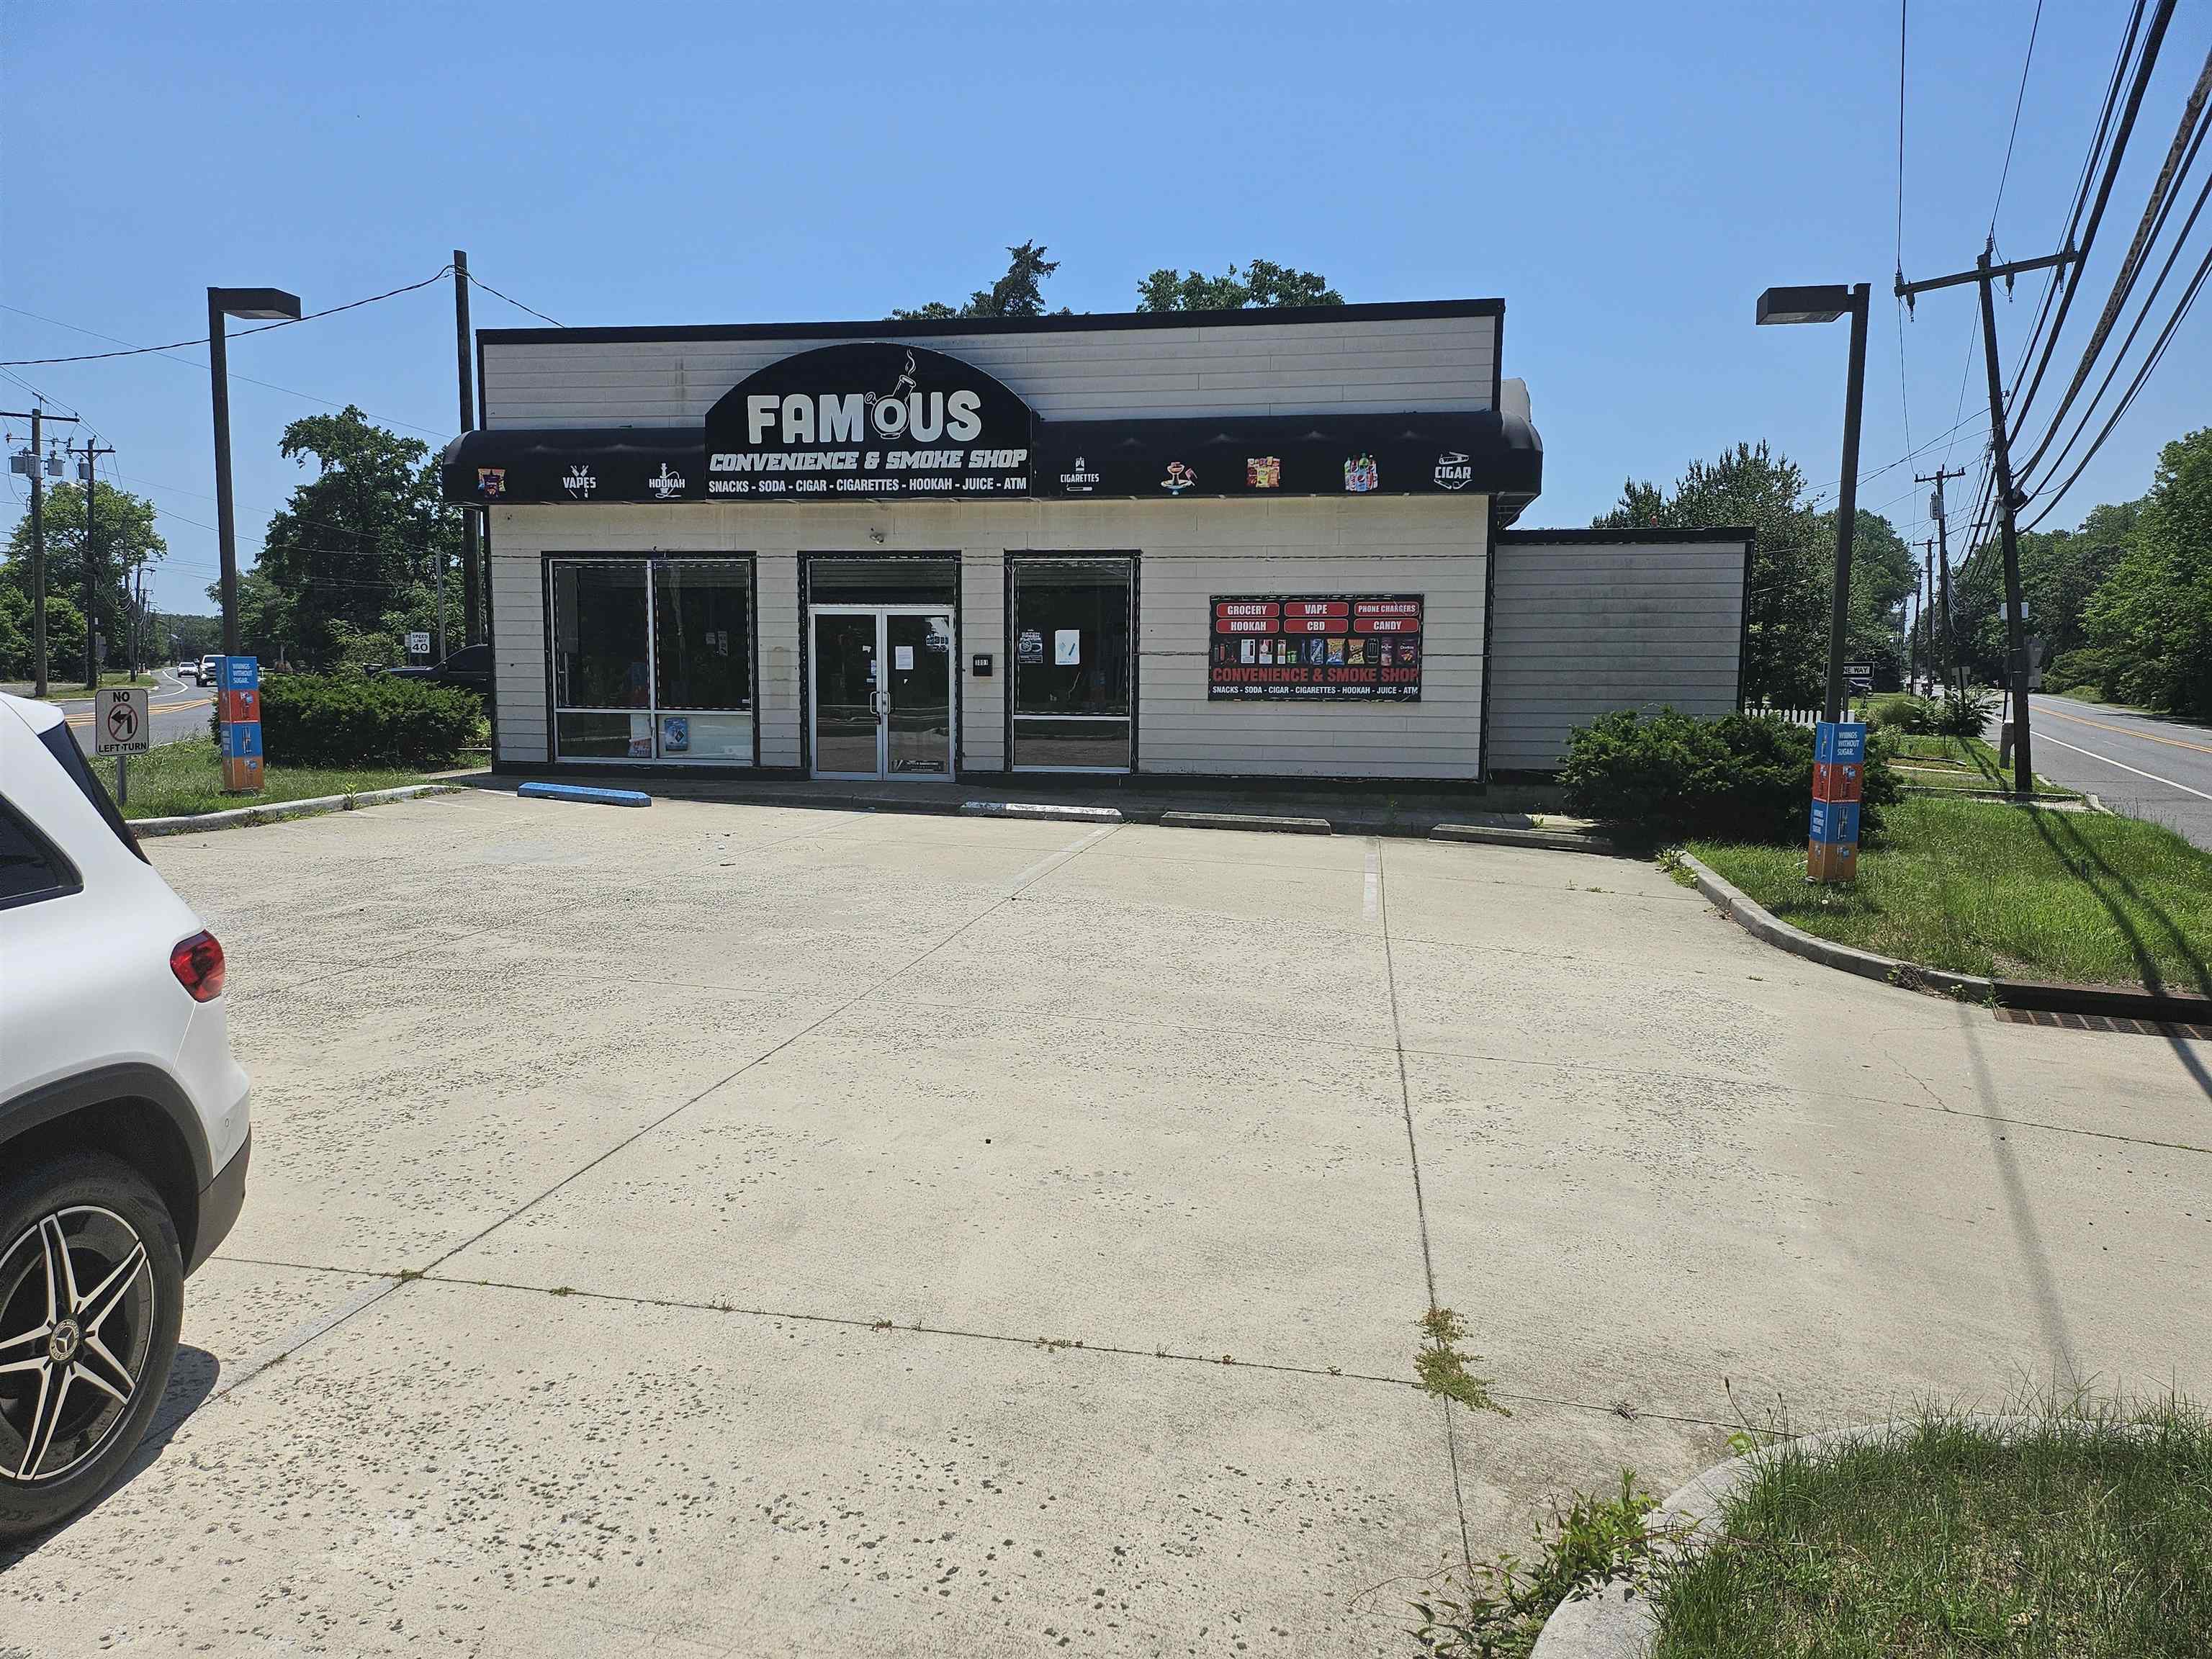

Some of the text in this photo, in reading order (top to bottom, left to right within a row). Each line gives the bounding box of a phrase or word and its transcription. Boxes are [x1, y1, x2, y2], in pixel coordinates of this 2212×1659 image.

[747, 390, 982, 444] FAMOUS
[709, 449, 1028, 472] CONVENIENCE & SMOKE SHOP
[1434, 466, 1472, 479] CIGAR
[562, 477, 596, 489] VAPES
[649, 478, 685, 488] HOOKAH
[1060, 473, 1100, 483] CIGARETTES
[709, 480, 749, 493] SNACKS
[758, 480, 786, 492] SODA
[796, 480, 827, 491] CIGAR
[836, 478, 899, 492] CIGARETTES
[909, 478, 952, 490] HOOKAH
[962, 478, 994, 490] JUICE
[1003, 477, 1027, 490] ATM
[1227, 605, 1267, 615] GROCERY
[1304, 604, 1328, 614] VAPE
[1380, 604, 1416, 613] CHARGERS
[1231, 621, 1267, 631] HOOKAH
[1307, 621, 1325, 631] CBD
[1373, 621, 1402, 630] CANDY
[1213, 668, 1308, 683] CONVENIENCE
[1313, 667, 1323, 682] &
[1327, 668, 1377, 683] SMOKE
[112, 691, 130, 702] NO
[98, 742, 147, 752] LEFT TURN
